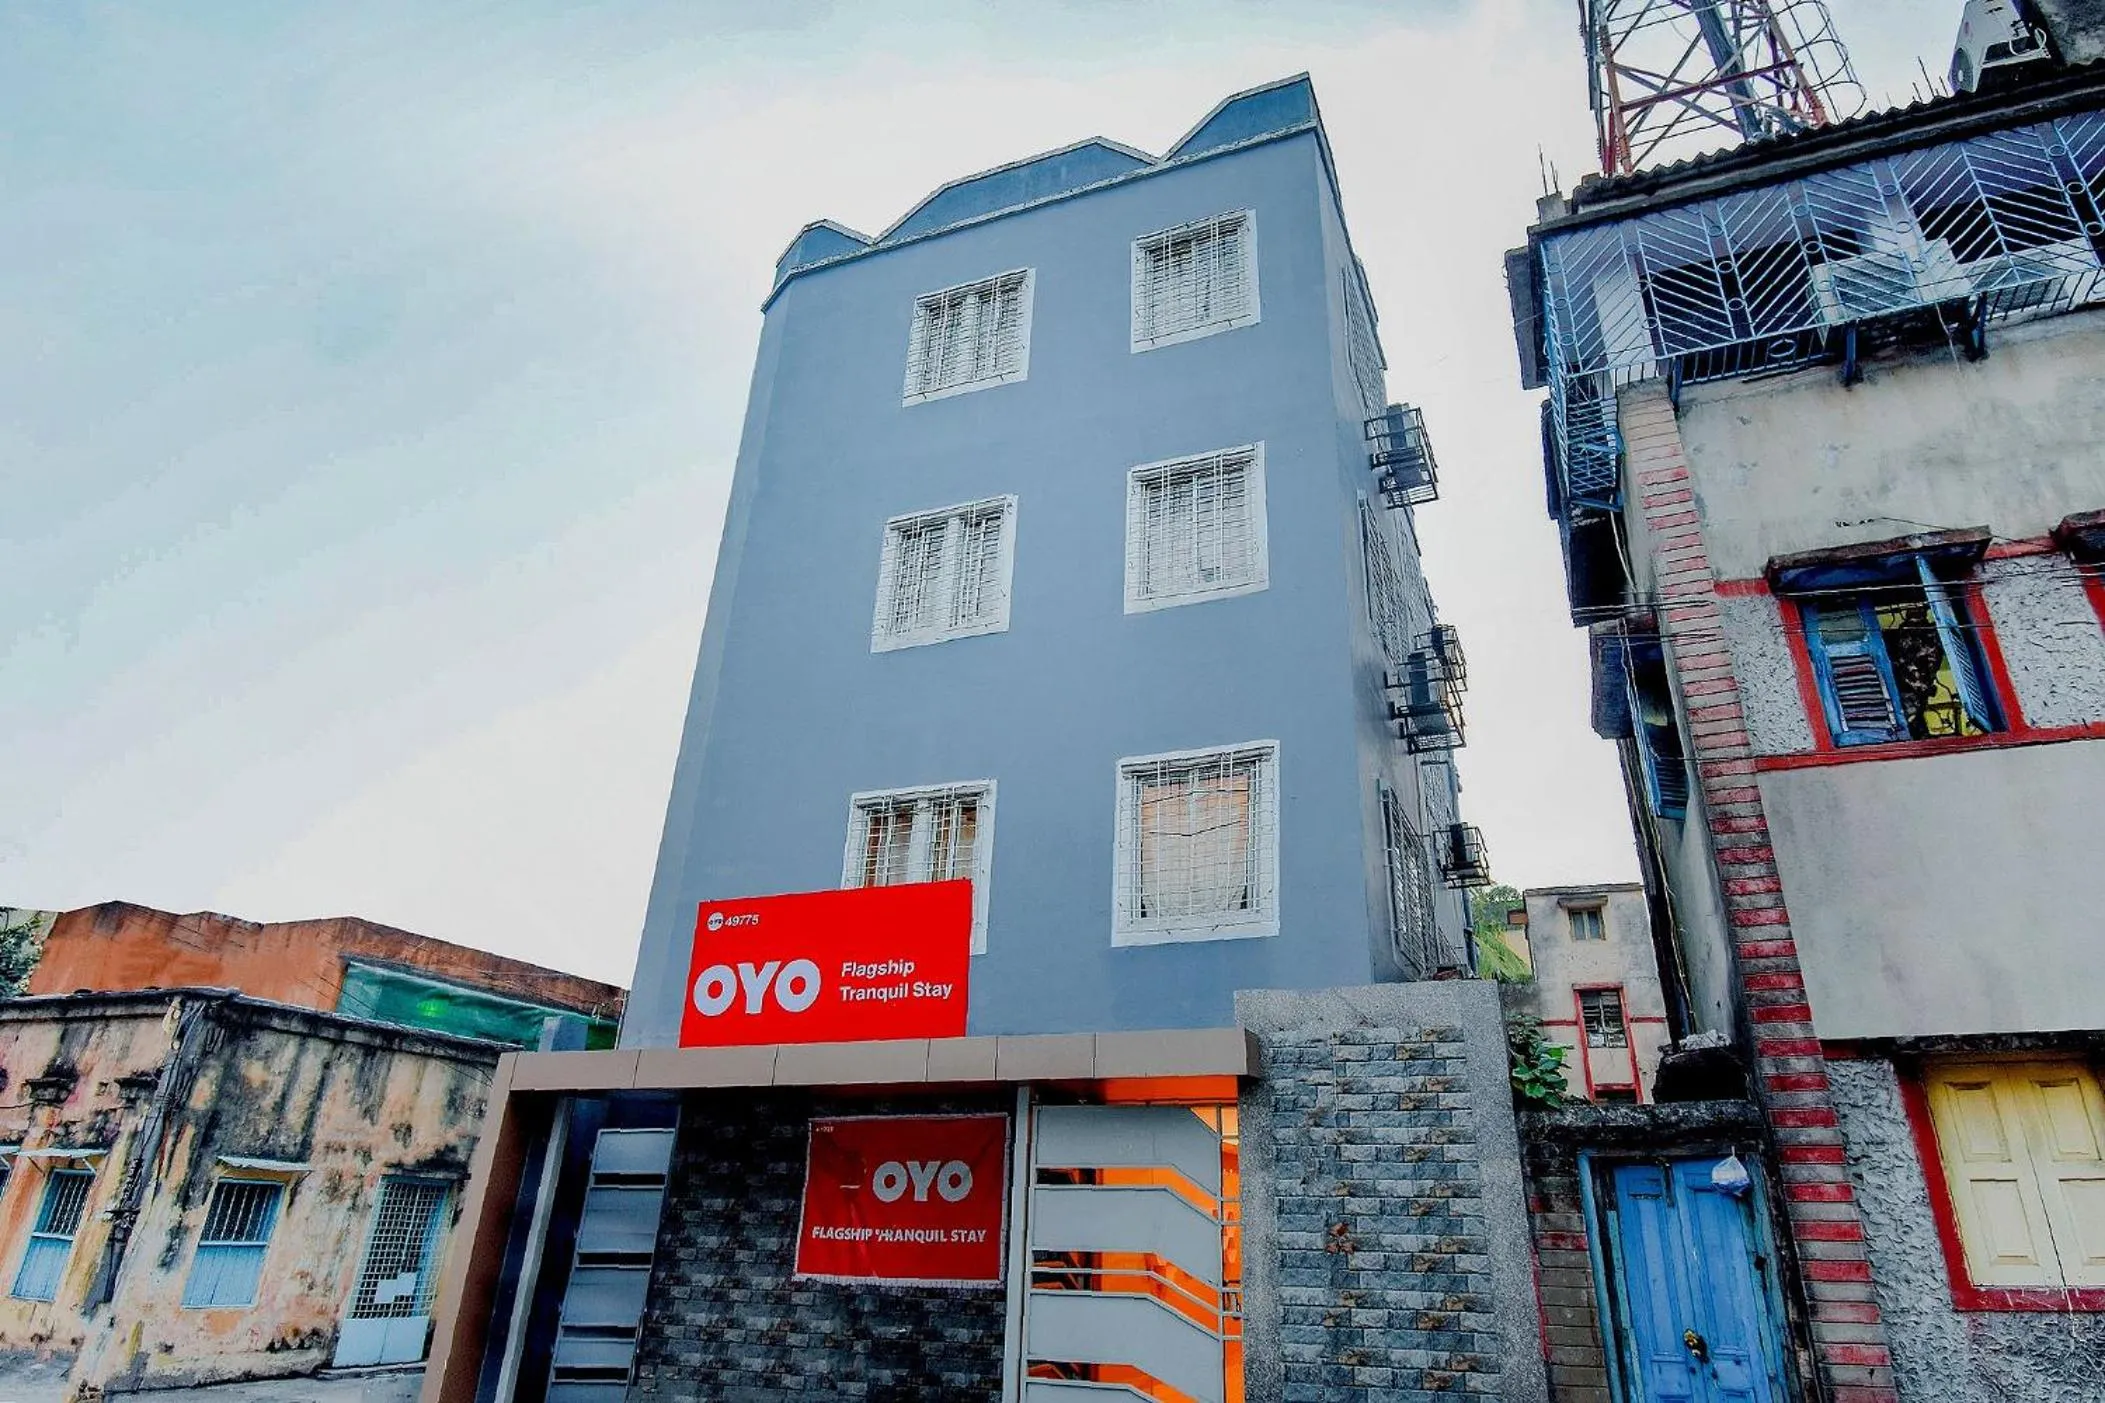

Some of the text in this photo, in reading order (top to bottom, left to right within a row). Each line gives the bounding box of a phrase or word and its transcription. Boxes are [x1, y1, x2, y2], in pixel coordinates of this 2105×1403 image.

[725, 914, 760, 926] 49775
[841, 959, 915, 978] Flagship
[693, 959, 821, 1016] OYO
[840, 981, 952, 1003] Tranquil Stay
[872, 1160, 973, 1203] OYO
[812, 1226, 872, 1242] FLAGSHIP
[950, 1229, 986, 1243] STAY
